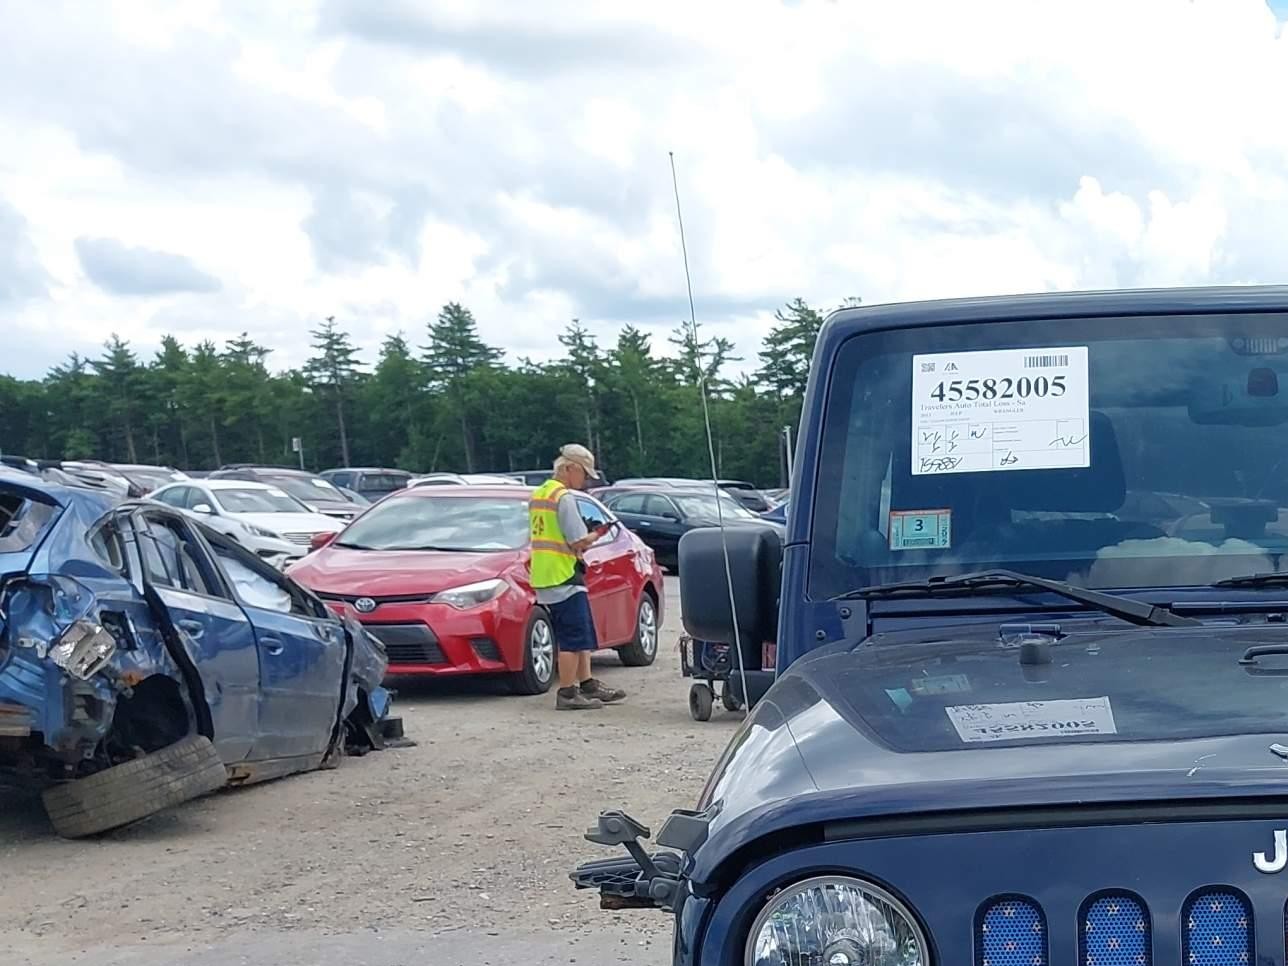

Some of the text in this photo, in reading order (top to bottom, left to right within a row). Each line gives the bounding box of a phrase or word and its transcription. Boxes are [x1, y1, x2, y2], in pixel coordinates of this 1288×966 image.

[931, 375, 1066, 402] 45582005
[920, 402, 952, 411] Travelers
[974, 400, 991, 408] Total
[915, 519, 923, 531] 3
